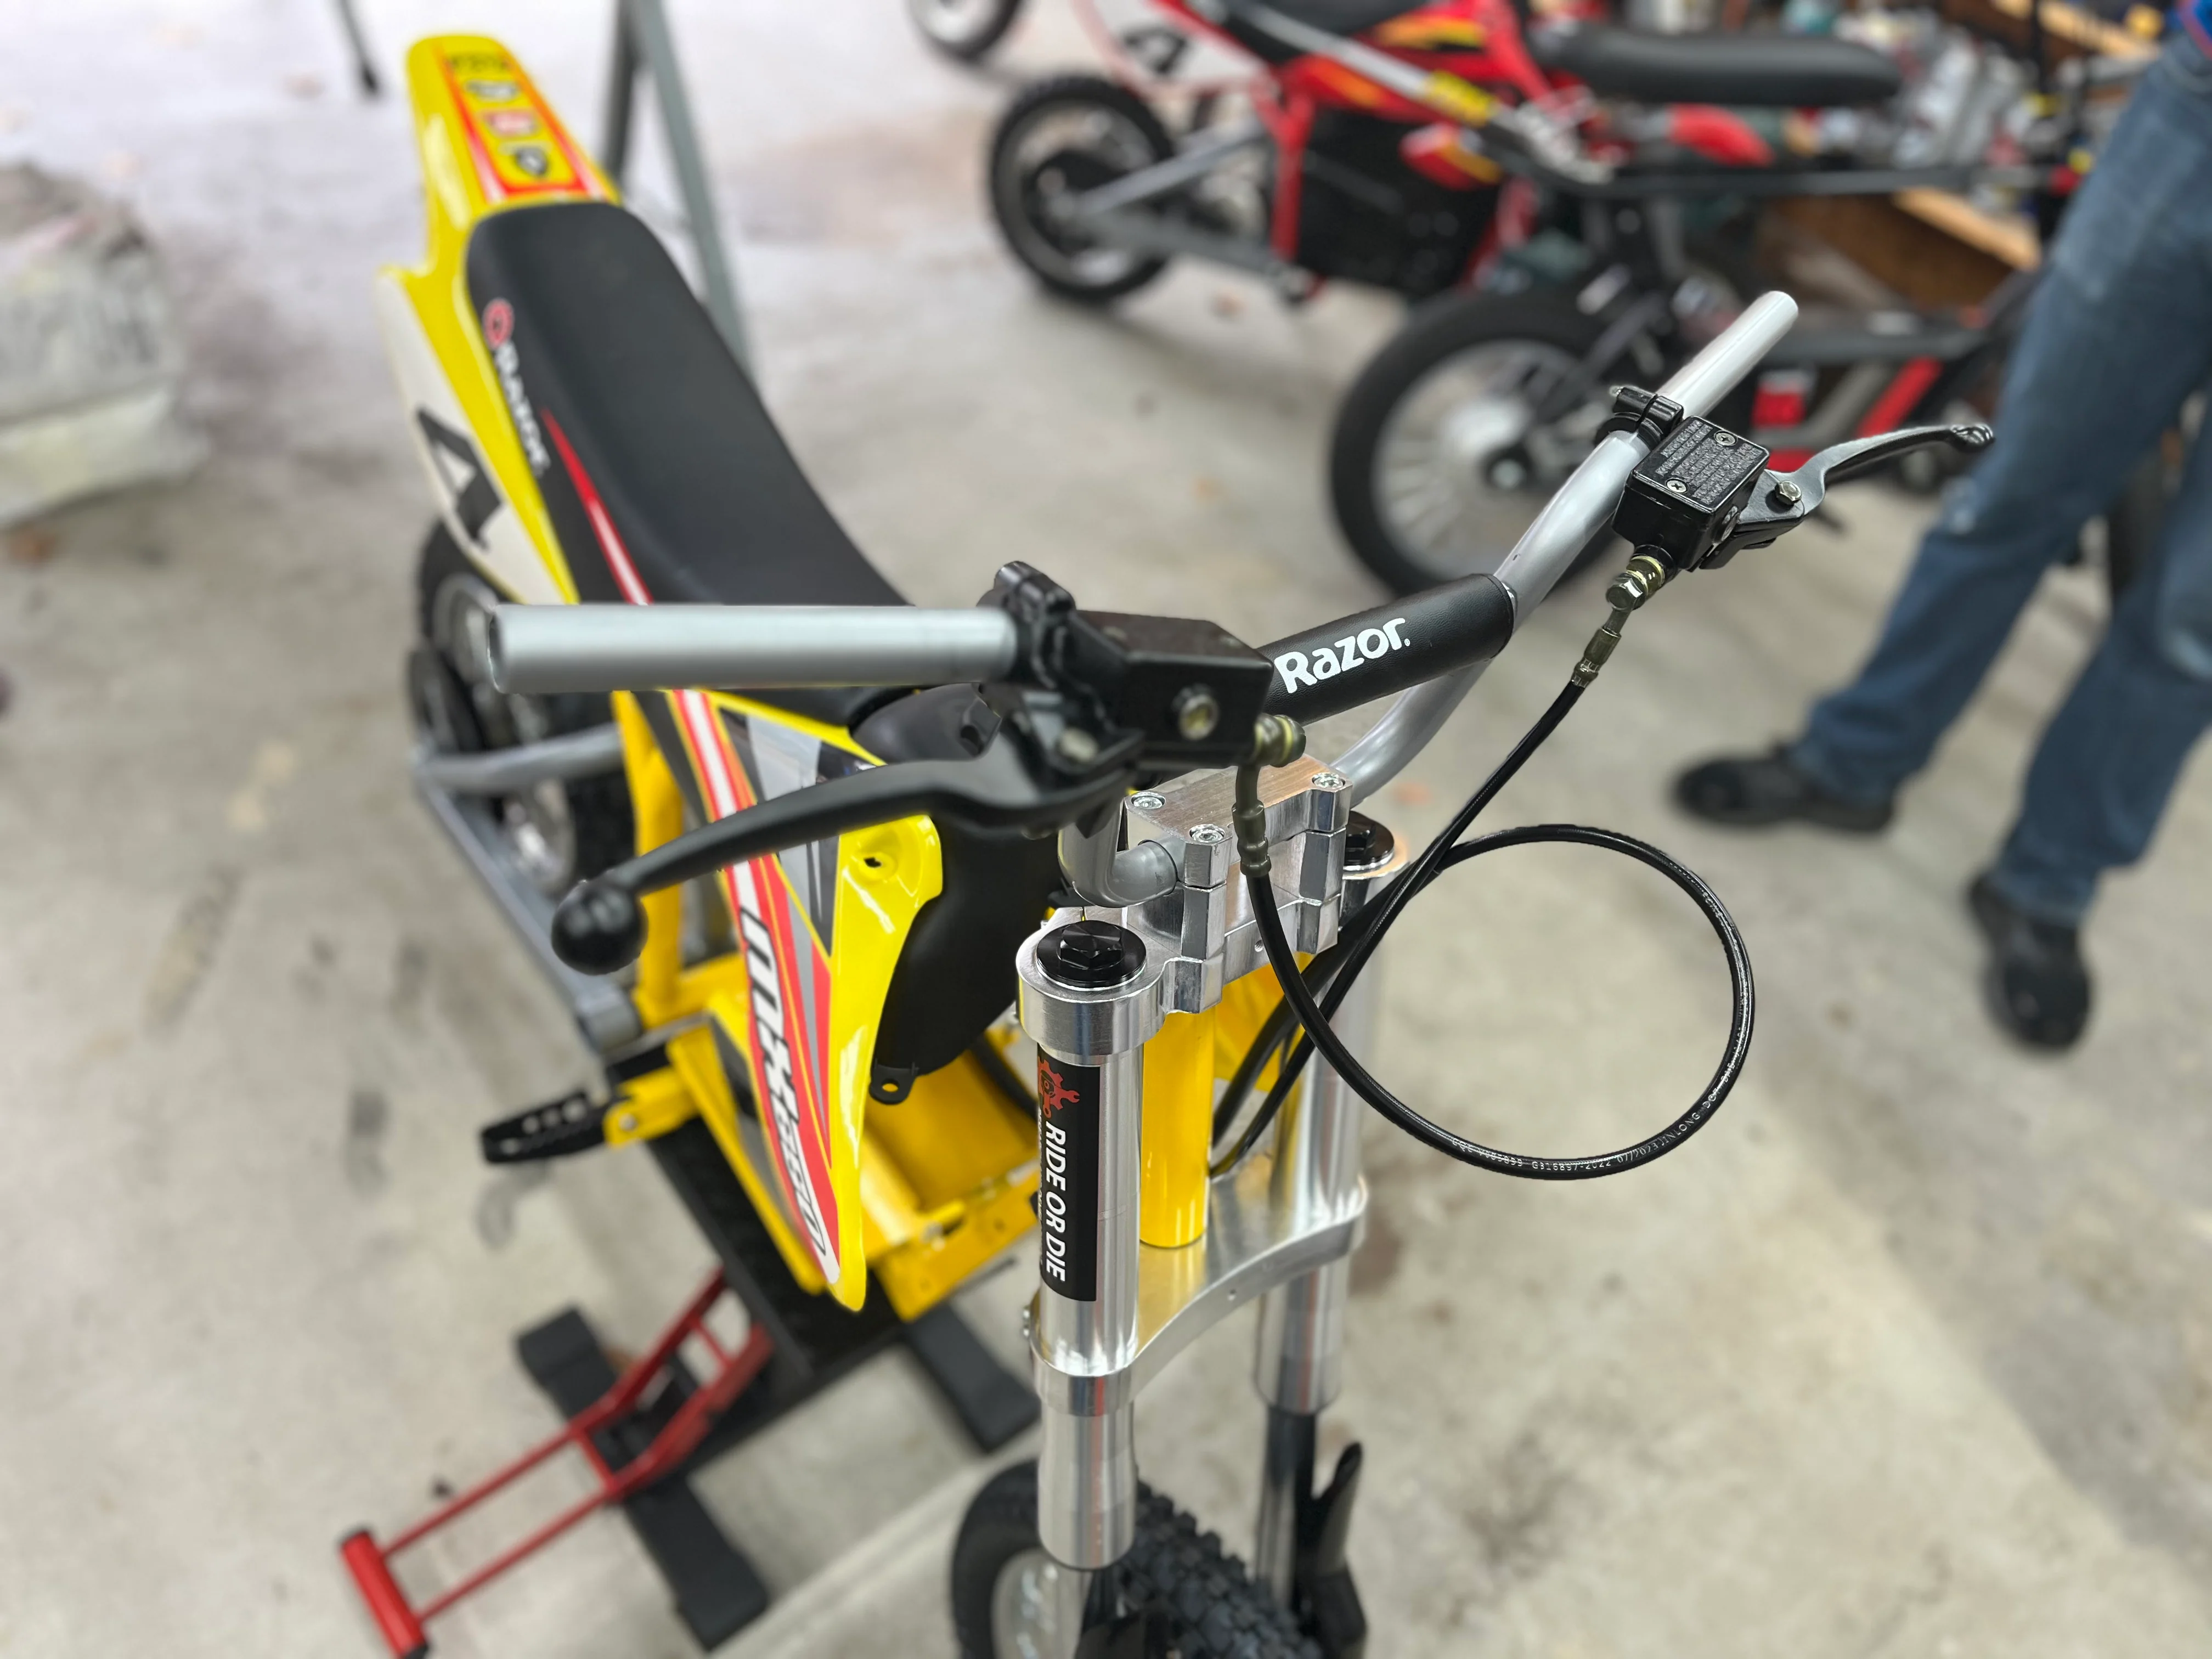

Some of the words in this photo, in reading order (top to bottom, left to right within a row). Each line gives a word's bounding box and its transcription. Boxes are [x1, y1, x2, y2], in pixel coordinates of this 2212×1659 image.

[1274, 618, 1406, 693] Razor
[1659, 1112, 1700, 1146] JINLONG
[1046, 1121, 1066, 1191] RIDE
[1046, 1190, 1066, 1233] OR
[1046, 1231, 1066, 1282] DIE
